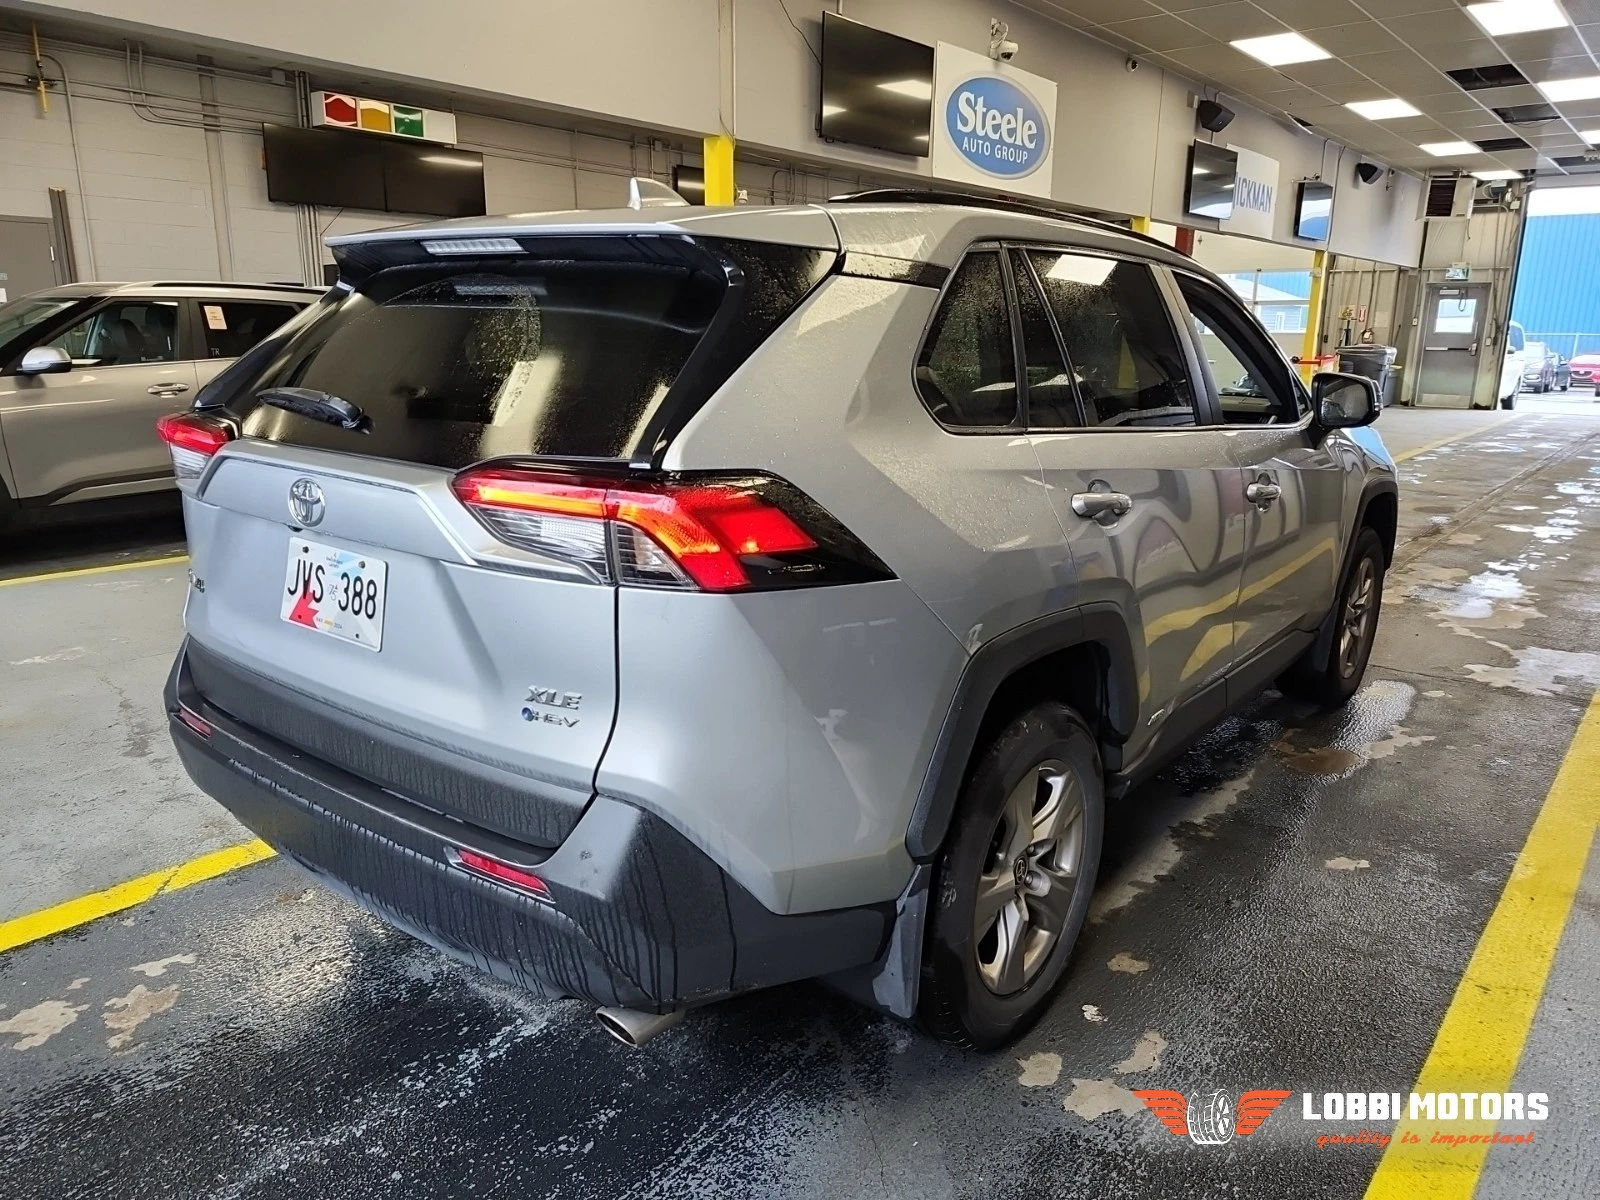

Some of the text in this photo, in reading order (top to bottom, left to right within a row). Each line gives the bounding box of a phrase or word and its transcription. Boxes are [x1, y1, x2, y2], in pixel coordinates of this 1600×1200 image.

[957, 91, 1037, 149] Steele
[962, 136, 1028, 164] AUTO GROUP
[287, 558, 378, 620] JVS 388
[524, 685, 582, 710] XLE
